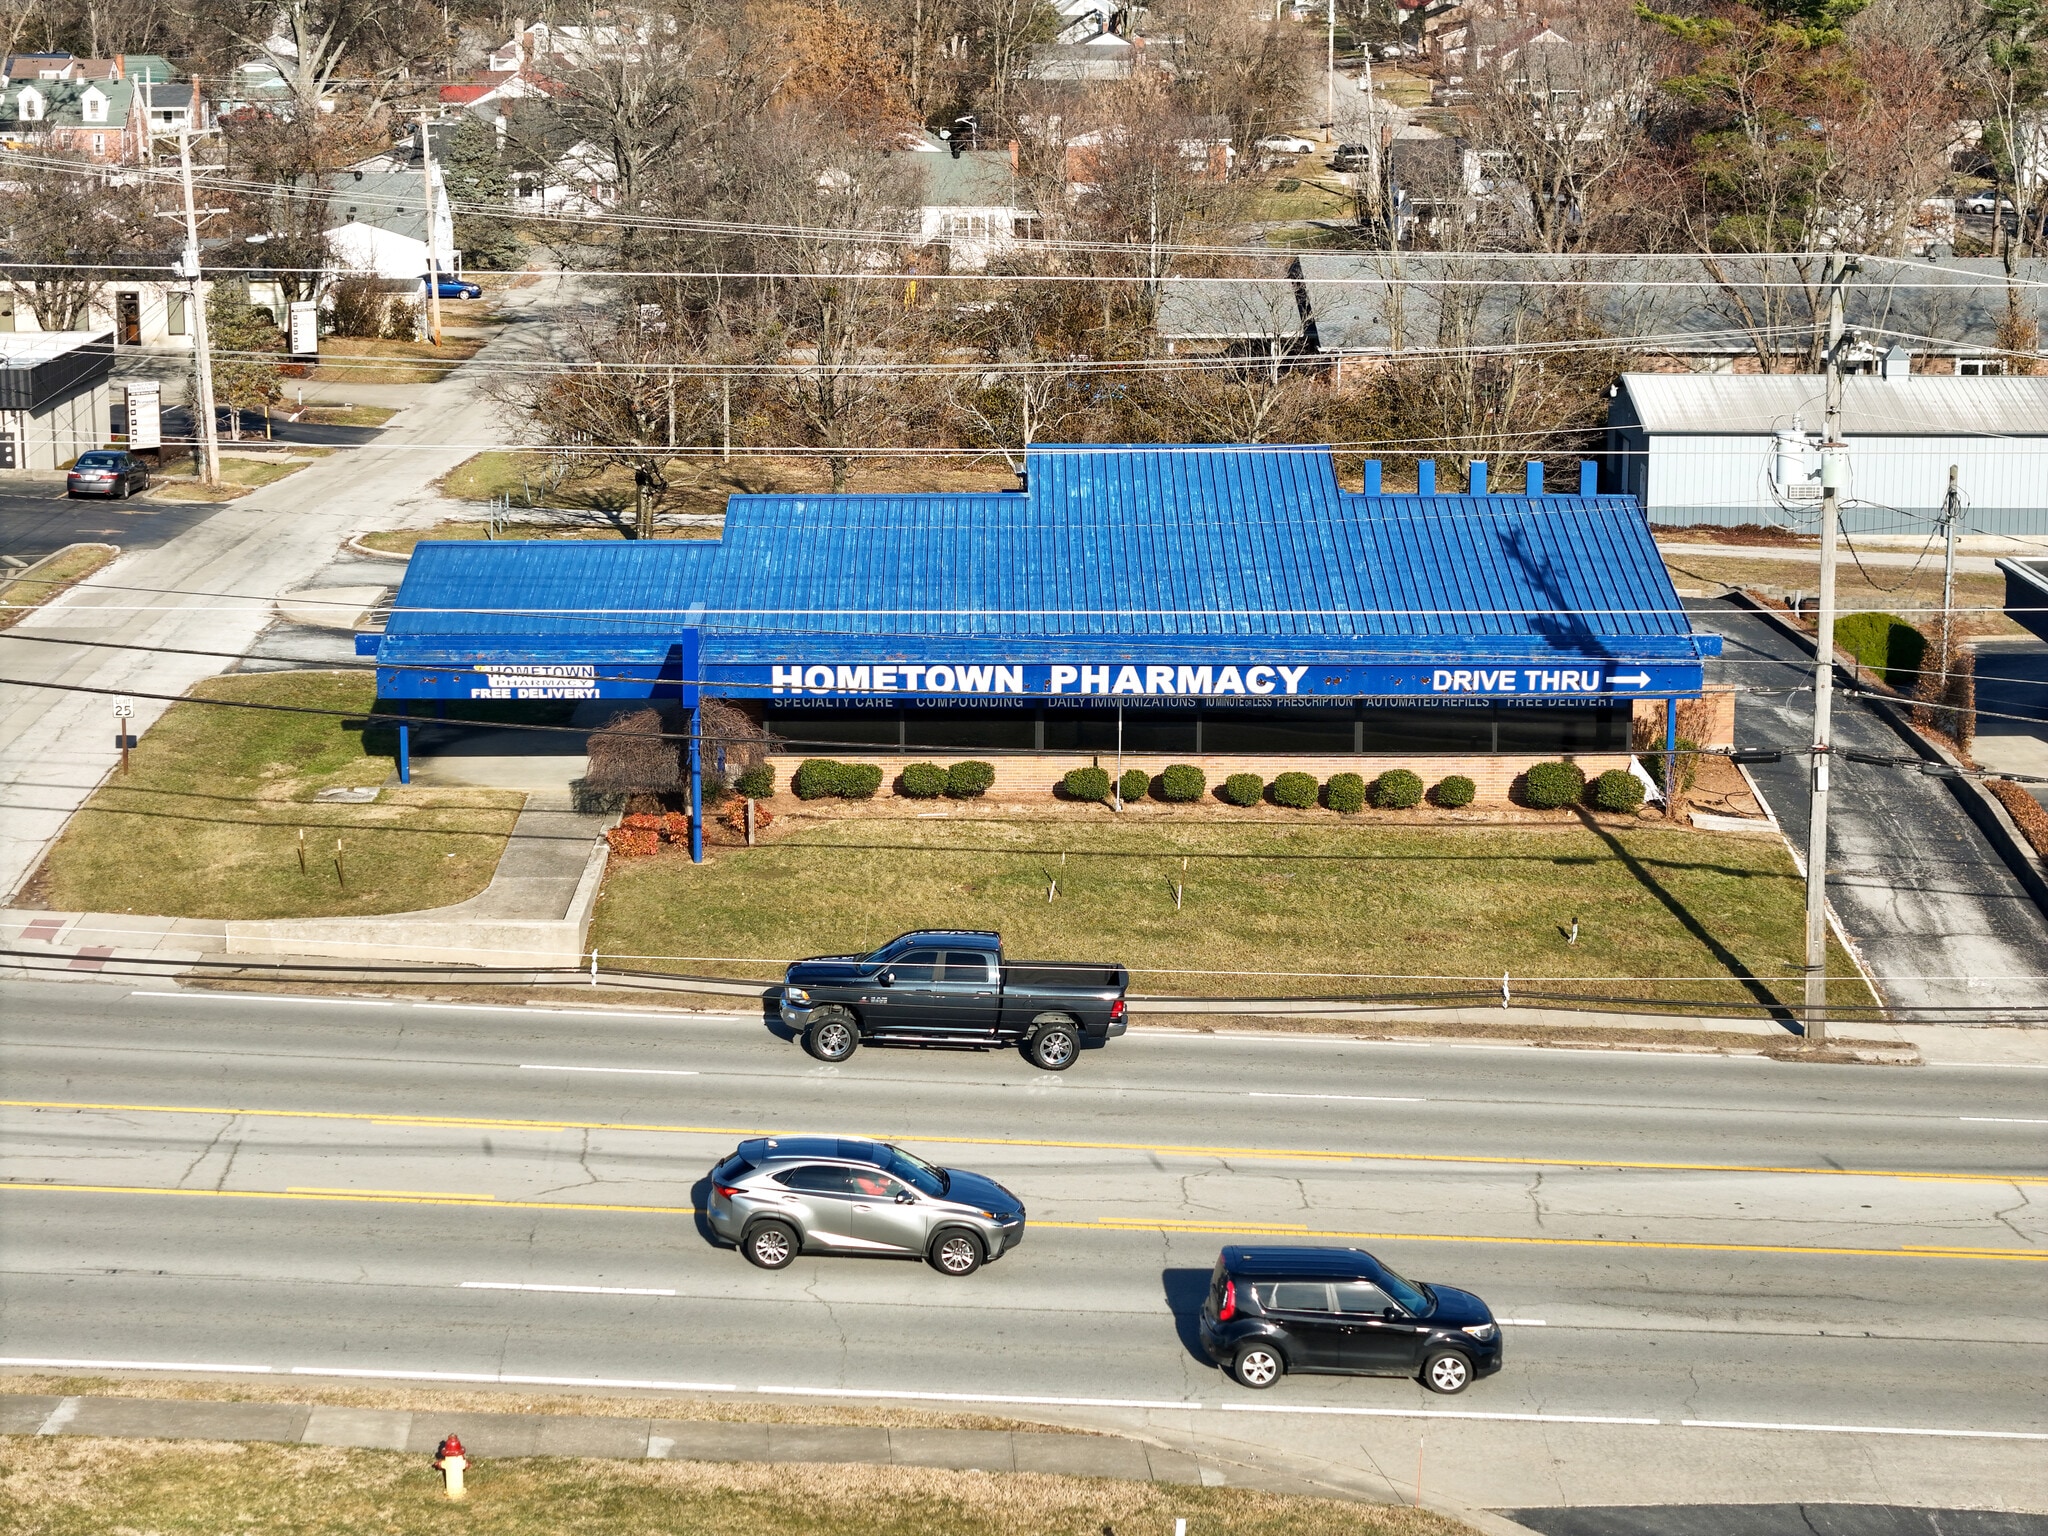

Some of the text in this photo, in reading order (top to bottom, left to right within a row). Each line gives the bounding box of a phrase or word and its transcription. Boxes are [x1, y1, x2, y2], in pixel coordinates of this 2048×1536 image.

[490, 666, 592, 678] HOMETOWN
[772, 665, 1309, 694] HOMETOWN PHARMACY
[1432, 670, 1600, 691] DRIVE THRU
[471, 688, 600, 699] FREE DELIVERY!
[774, 698, 893, 707] SPECIALTY CARE
[916, 698, 1024, 707] COMPOUNDING
[1047, 698, 1196, 707] DAILY IMMUNIZATIONS
[1252, 698, 1272, 707] LESS
[1277, 698, 1354, 707] PRESCRIPTION
[1366, 698, 1490, 707] AUTOMATED REFILLS
[1507, 698, 1615, 707] FREE DELIVERY
[115, 705, 131, 716] 25
